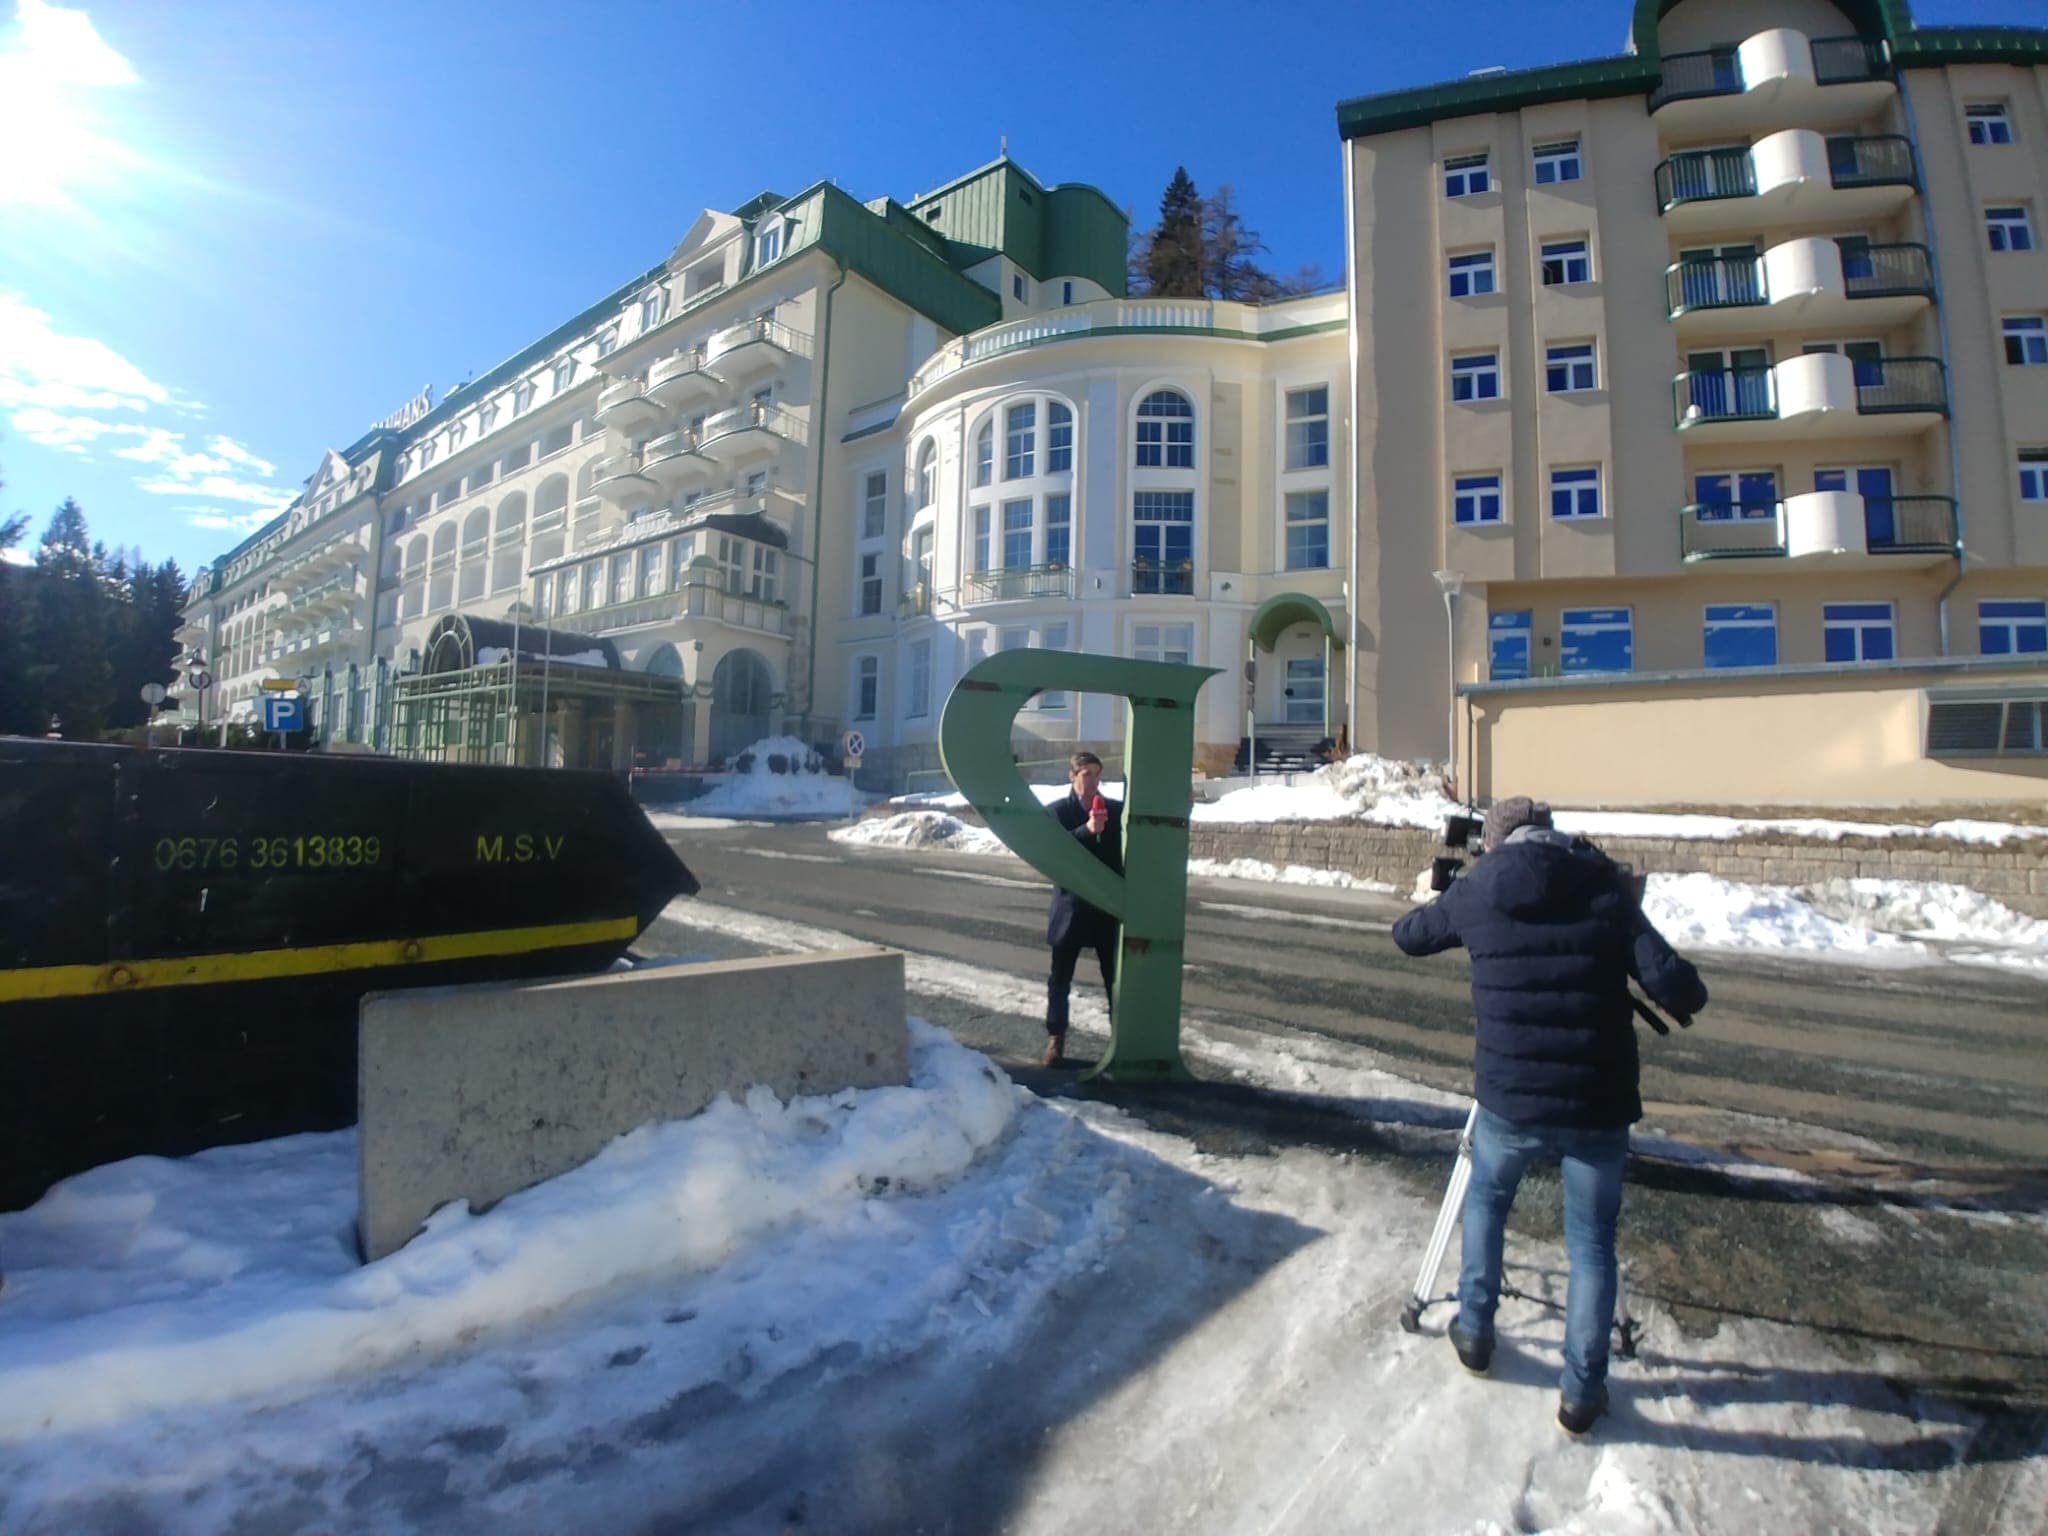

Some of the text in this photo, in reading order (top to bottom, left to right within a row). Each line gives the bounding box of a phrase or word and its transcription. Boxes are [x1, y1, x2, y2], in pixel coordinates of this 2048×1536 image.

[273, 701, 295, 727] P
[155, 835, 380, 870] 0676 3613839
[477, 833, 563, 861] M.S.V
